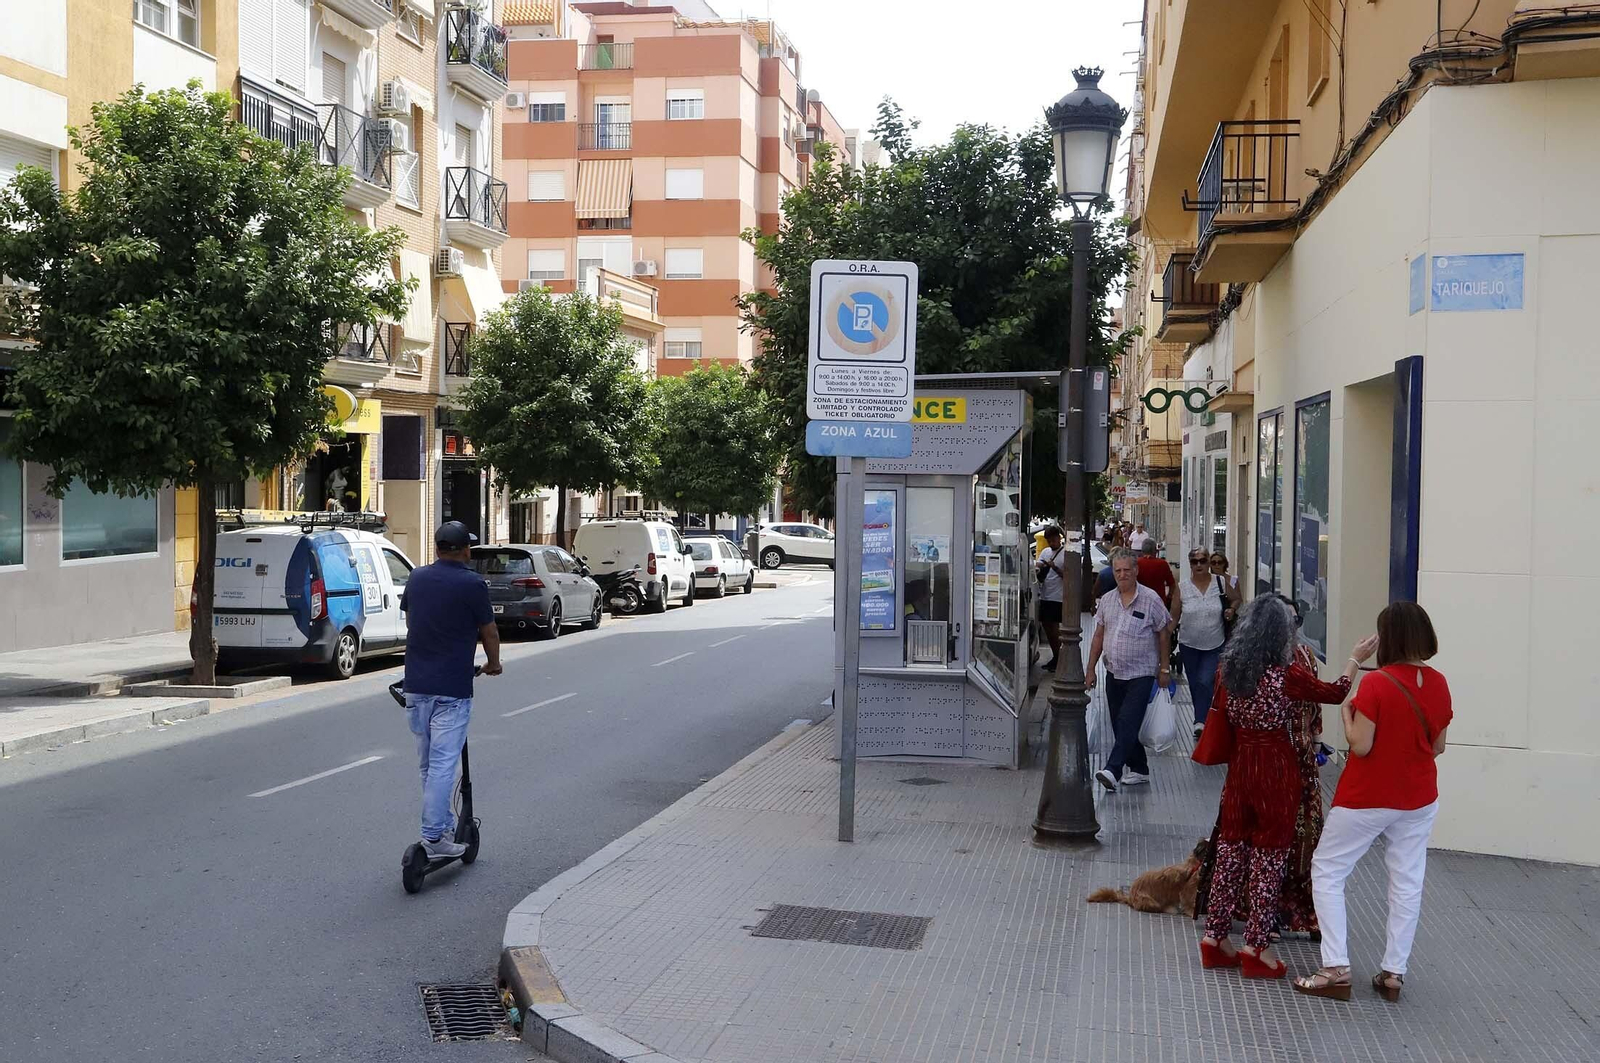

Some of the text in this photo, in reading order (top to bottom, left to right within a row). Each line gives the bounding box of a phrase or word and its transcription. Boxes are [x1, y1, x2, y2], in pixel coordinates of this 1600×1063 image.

[849, 264, 880, 272] O.R.A.
[1436, 281, 1504, 296] TARIQUEJO
[845, 398, 907, 406] ESTACIONAMIENTO
[821, 426, 856, 436] ZONA
[864, 427, 898, 439] AZUL
[220, 617, 256, 626] 5993 LHJ
